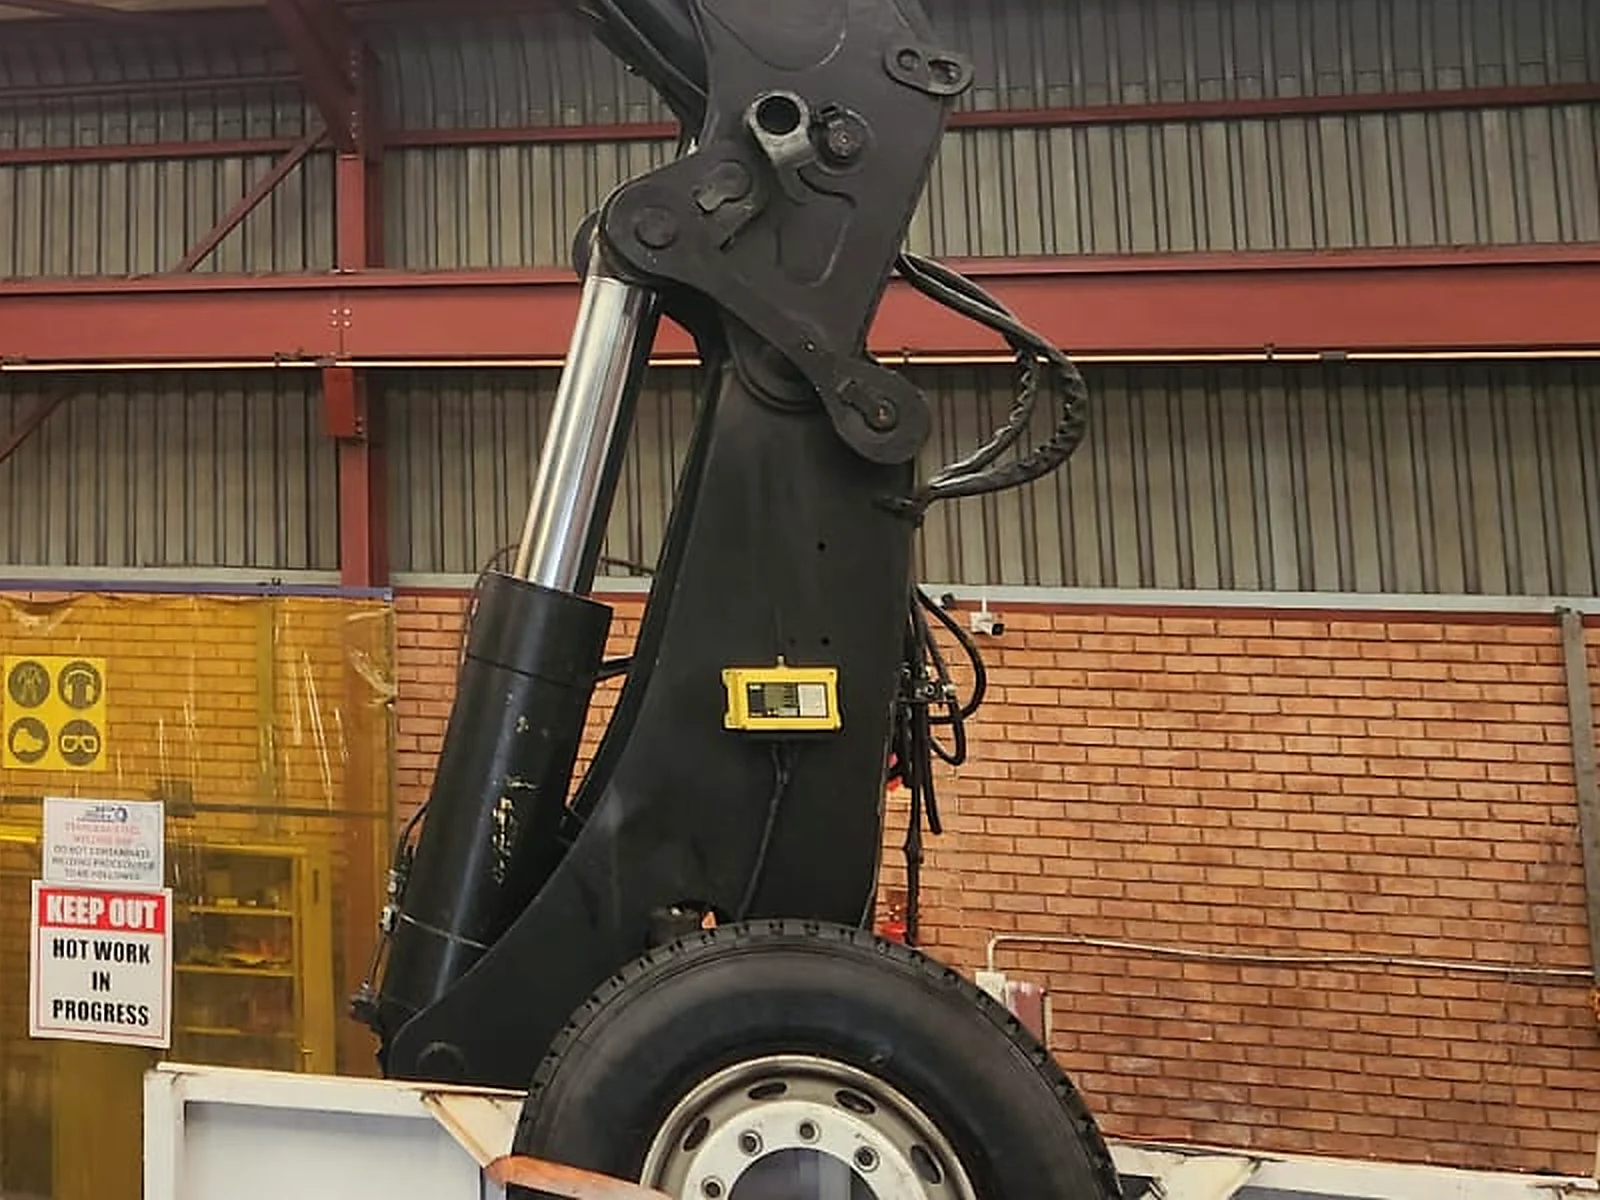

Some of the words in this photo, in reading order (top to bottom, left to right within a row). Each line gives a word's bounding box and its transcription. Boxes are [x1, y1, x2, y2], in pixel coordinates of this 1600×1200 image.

[47, 894, 104, 926] KEEP
[108, 897, 158, 929] OUT
[52, 938, 89, 960] HOT
[93, 940, 150, 964] WORK
[92, 971, 110, 992] IN
[52, 999, 149, 1027] PROGRESS
